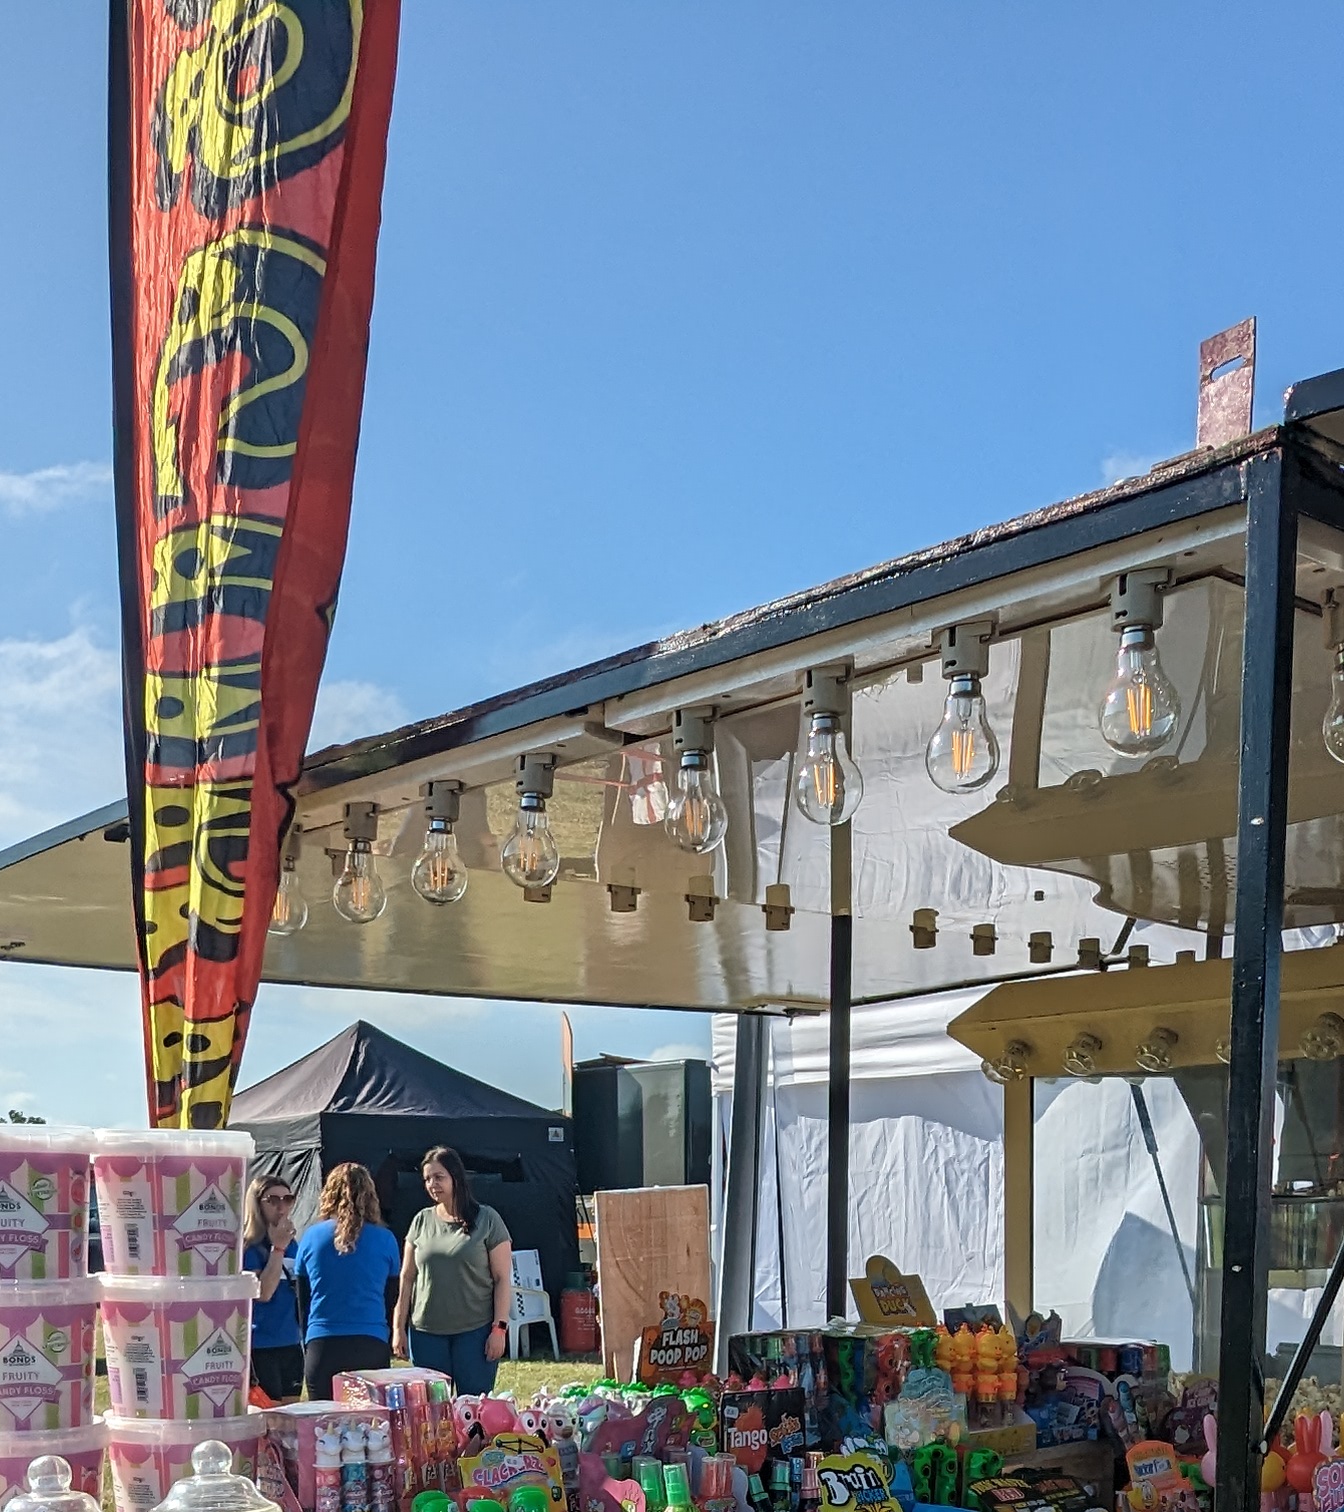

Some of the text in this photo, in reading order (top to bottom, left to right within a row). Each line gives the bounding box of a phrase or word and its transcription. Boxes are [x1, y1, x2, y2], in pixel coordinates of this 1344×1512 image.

[9, 1233, 39, 1243] FLOSS
[662, 1329, 699, 1346] FLASH
[3, 1356, 36, 1364] BONDS
[650, 1345, 708, 1365] POOP POP
[205, 1361, 234, 1370] FRUITY
[2, 1372, 39, 1380] FRUITY
[24, 1386, 53, 1395] FLOSS
[729, 1429, 768, 1450] Tango
[820, 1466, 881, 1505] Brain
